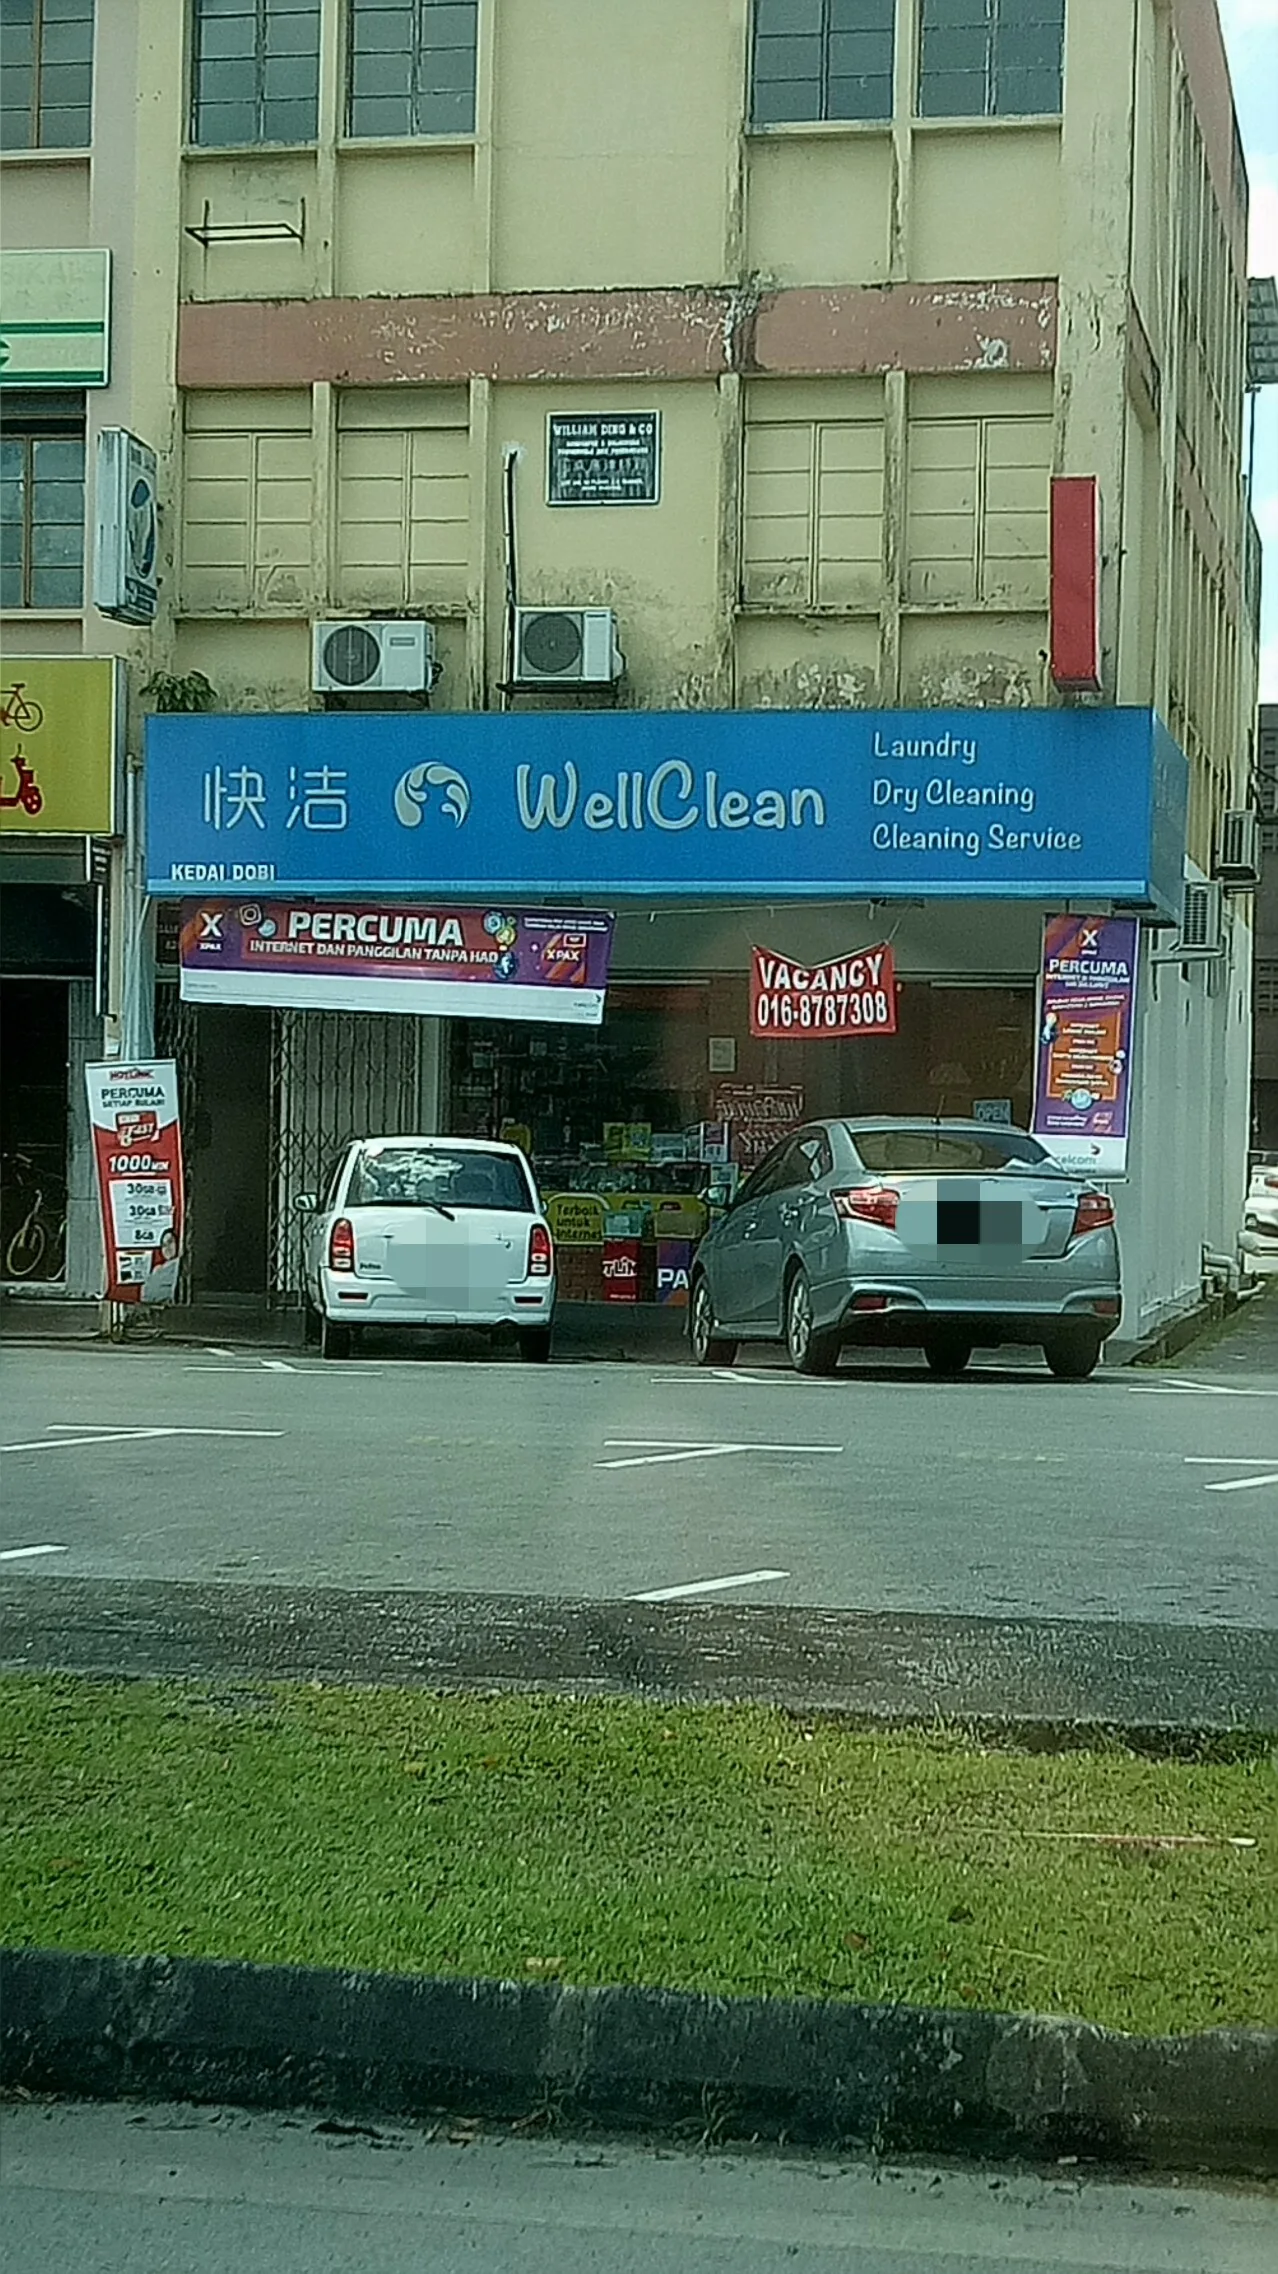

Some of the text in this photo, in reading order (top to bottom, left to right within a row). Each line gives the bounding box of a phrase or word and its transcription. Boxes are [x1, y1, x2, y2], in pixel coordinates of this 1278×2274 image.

[873, 731, 977, 765] Laundry
[203, 764, 347, 831] 快洁
[516, 759, 825, 831] WellClean
[872, 778, 1035, 813] Dry Cleaning
[872, 822, 1082, 857] Cleaning Service
[171, 863, 275, 881] KEDAI DOBI
[287, 911, 465, 947] PERCUMA
[249, 939, 499, 964] INTERNET DAN PANGGILAN TANPA HAD
[1049, 959, 1128, 976] PERCUMA
[758, 953, 883, 991] VACANCY
[757, 990, 888, 1027] 016-8787308
[101, 1086, 165, 1100] PERCUMA
[102, 1100, 134, 1108] SETIAP
